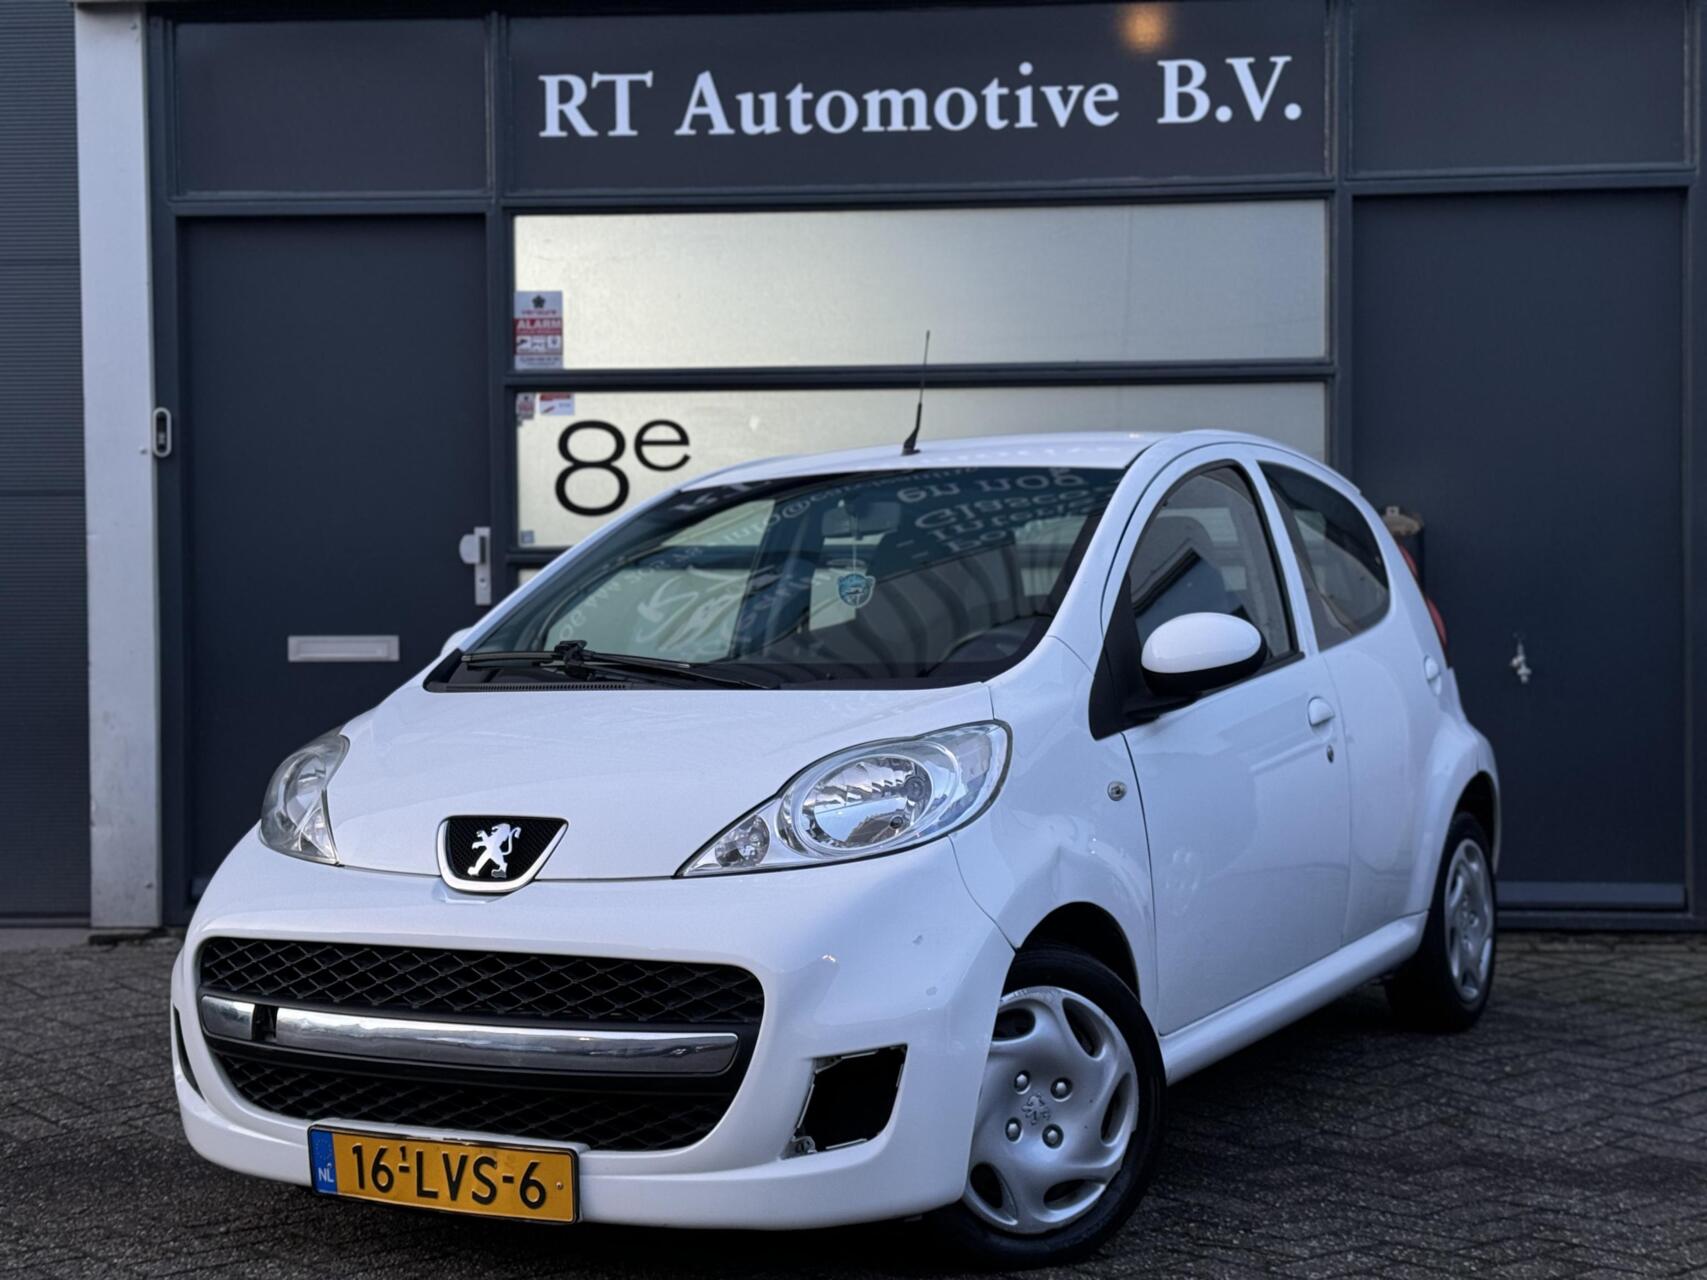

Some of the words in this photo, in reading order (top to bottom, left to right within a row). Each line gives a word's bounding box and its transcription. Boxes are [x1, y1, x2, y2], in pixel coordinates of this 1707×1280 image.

[538, 71, 654, 139] RT
[674, 62, 1120, 138] Automotive
[1156, 55, 1303, 126] B.V.
[516, 318, 562, 329] ALARM
[318, 1166, 335, 1184] NL
